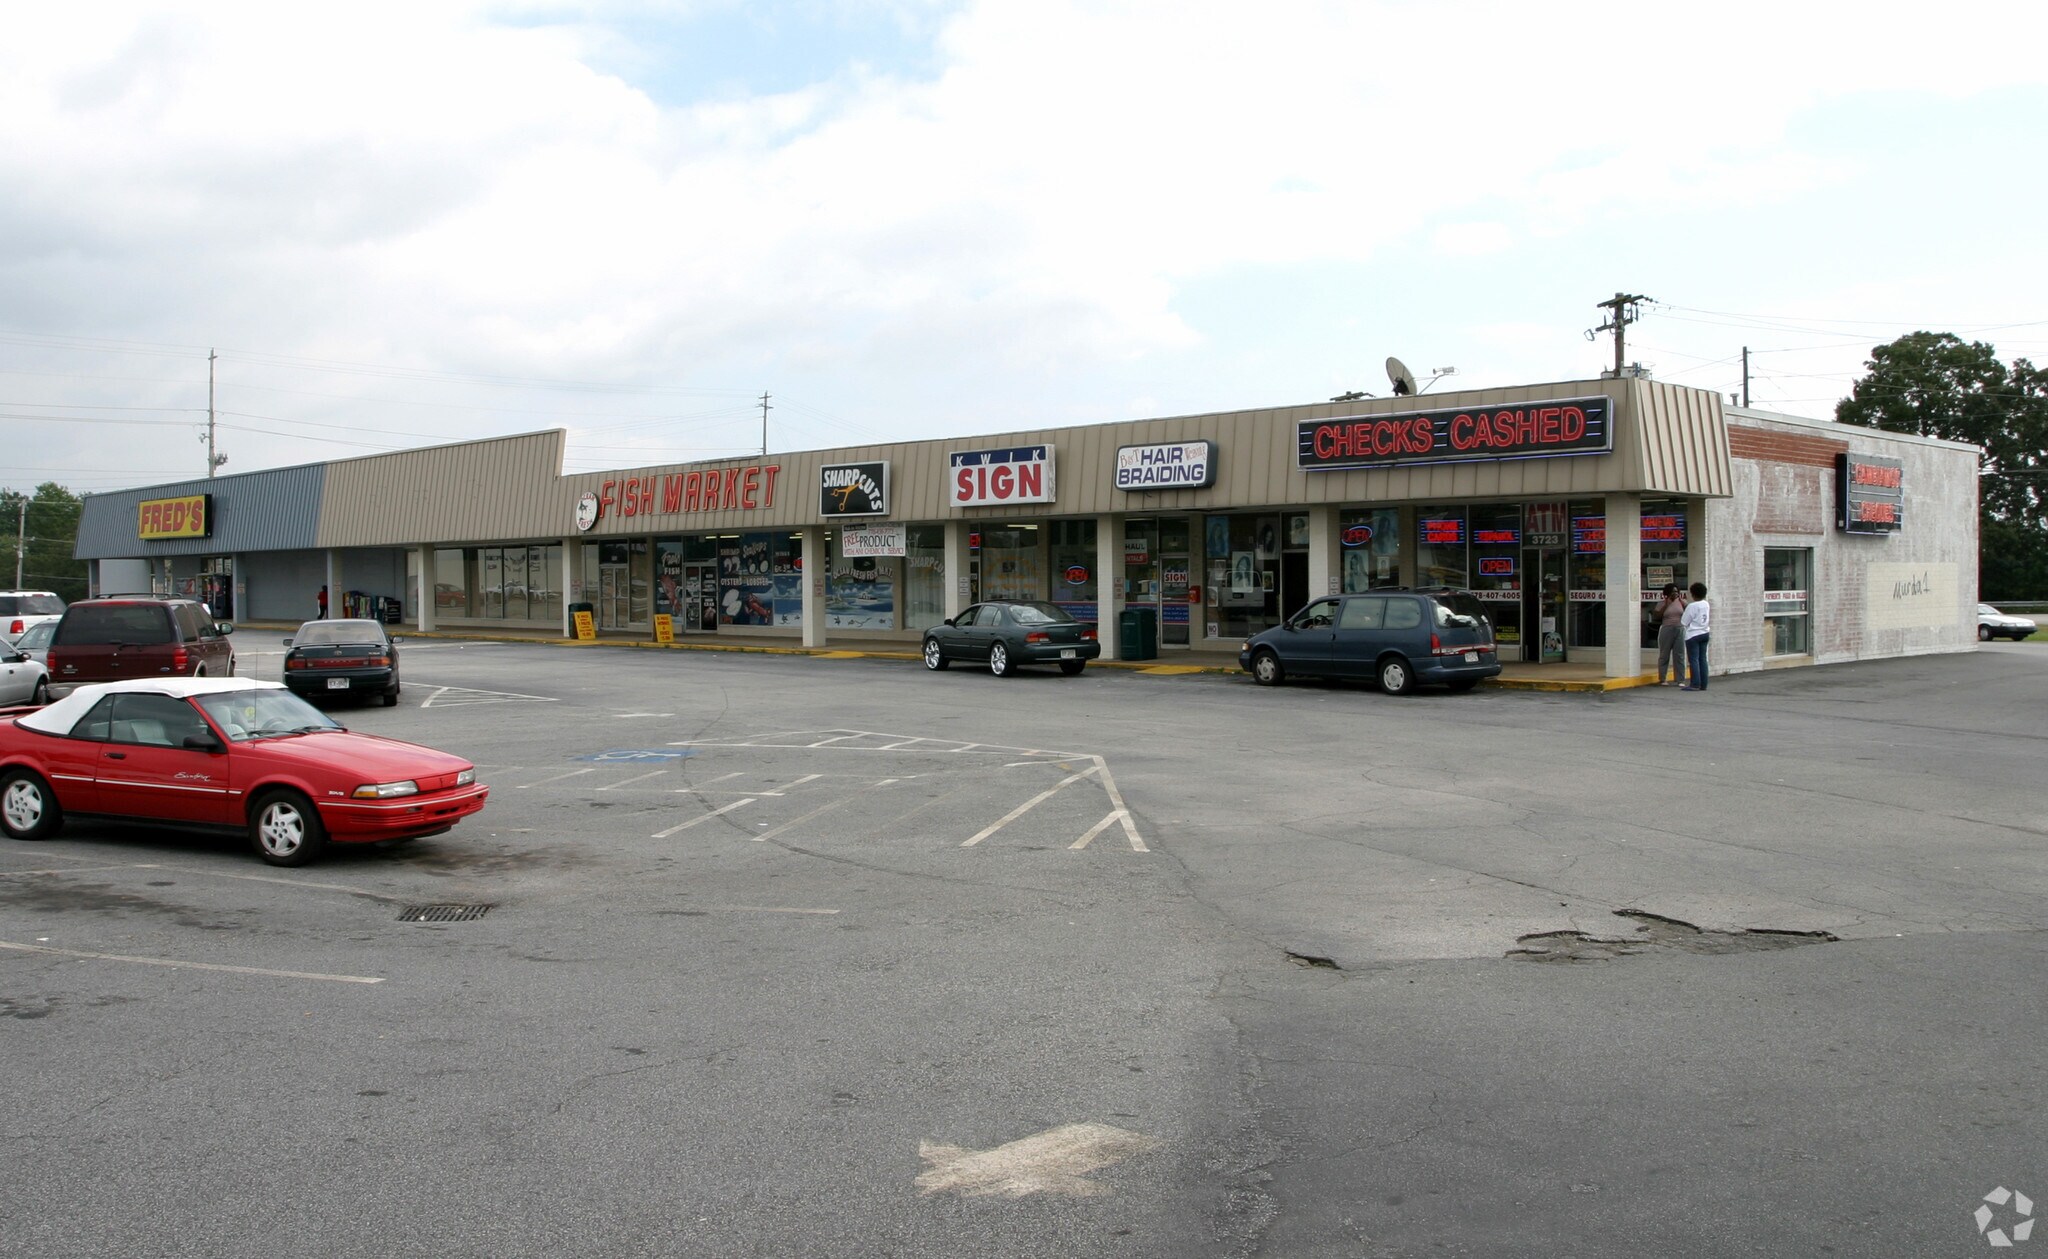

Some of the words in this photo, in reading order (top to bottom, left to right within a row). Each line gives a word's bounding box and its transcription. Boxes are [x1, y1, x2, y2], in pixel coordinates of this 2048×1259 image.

[1314, 418, 1433, 459] CHECKS
[1450, 407, 1585, 450] CASHED
[1141, 447, 1183, 465] HAIR
[957, 464, 1042, 501] SIGN
[1118, 464, 1204, 485] BRAIDING
[600, 476, 656, 518] FISH
[662, 465, 780, 513] MARKET
[823, 469, 860, 488] SHARP
[859, 474, 883, 510] CUTS
[140, 500, 203, 533] FRED'S
[1525, 503, 1566, 532] ATM
[844, 532, 860, 547] FREE
[860, 535, 895, 547] PRODUCT
[1343, 530, 1371, 543] OPEN
[1532, 535, 1559, 544] 3723
[1481, 561, 1511, 573] OPEN
